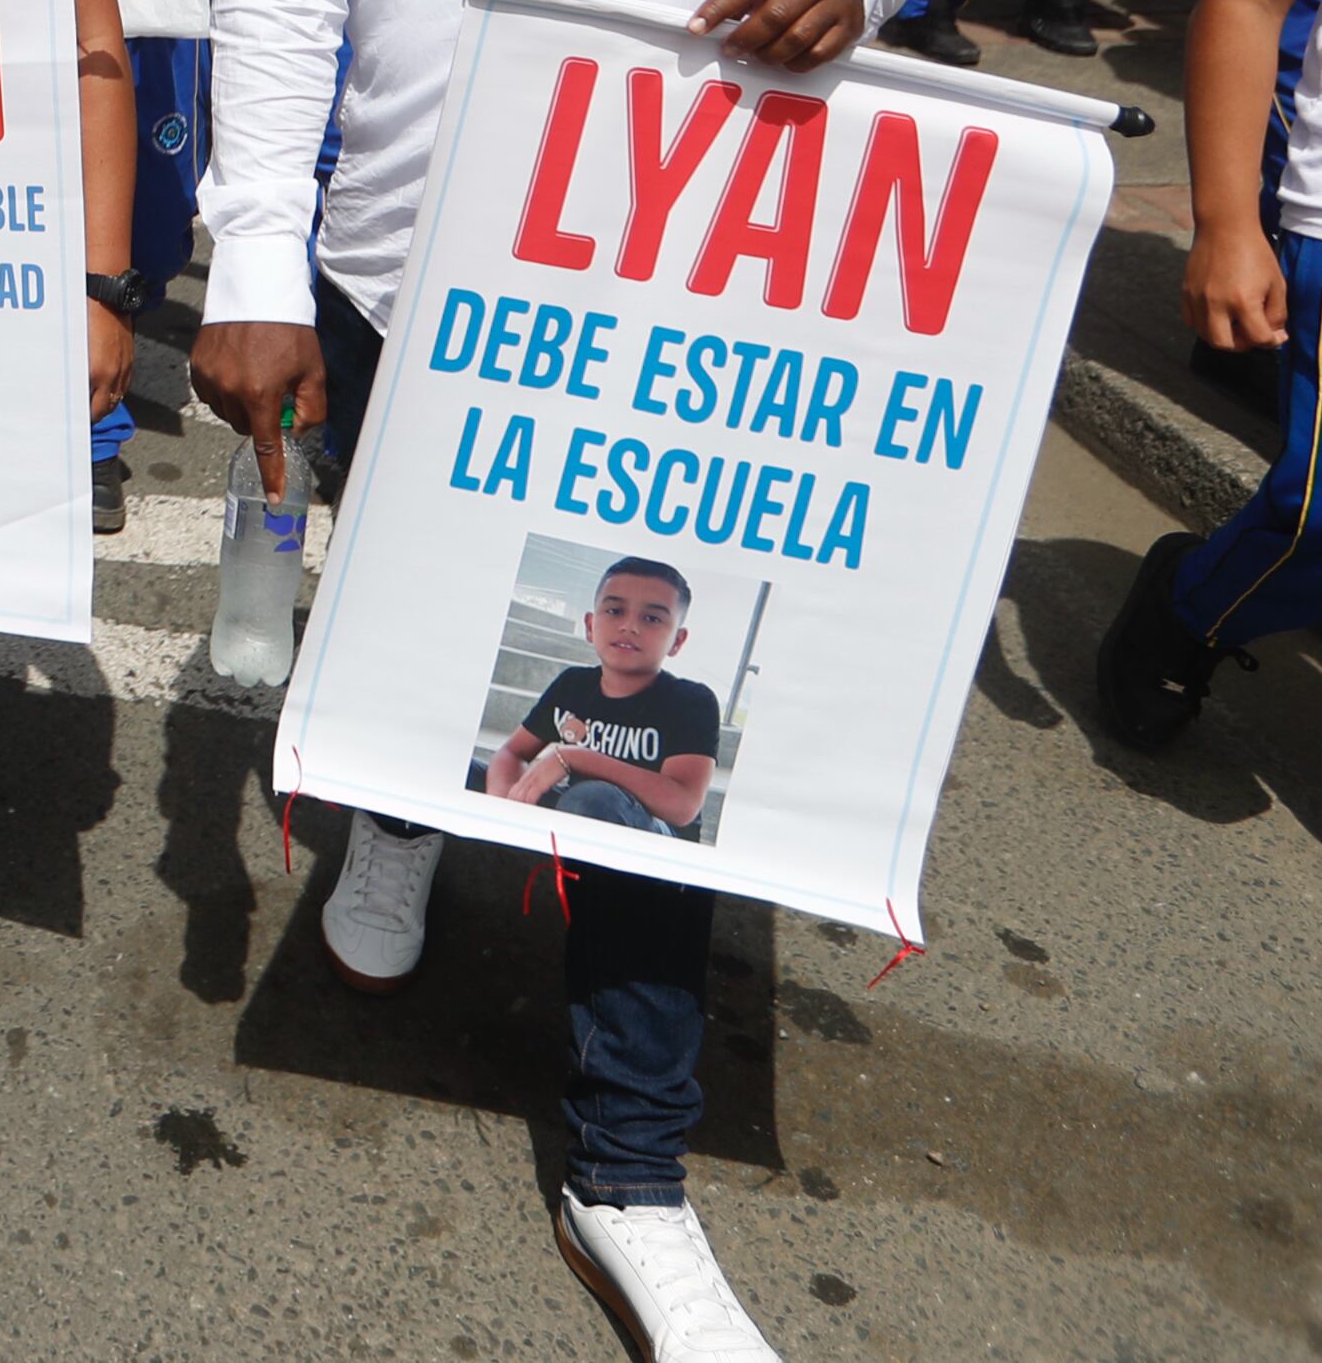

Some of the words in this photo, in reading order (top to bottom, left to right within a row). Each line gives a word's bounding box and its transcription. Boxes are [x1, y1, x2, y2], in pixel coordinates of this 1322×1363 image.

[510, 55, 1001, 337] LYAN
[428, 287, 620, 402] DEBE
[631, 324, 861, 450] ESTAR
[873, 369, 985, 472] EN
[449, 405, 537, 503] LA
[553, 426, 873, 571] ESCUELA
